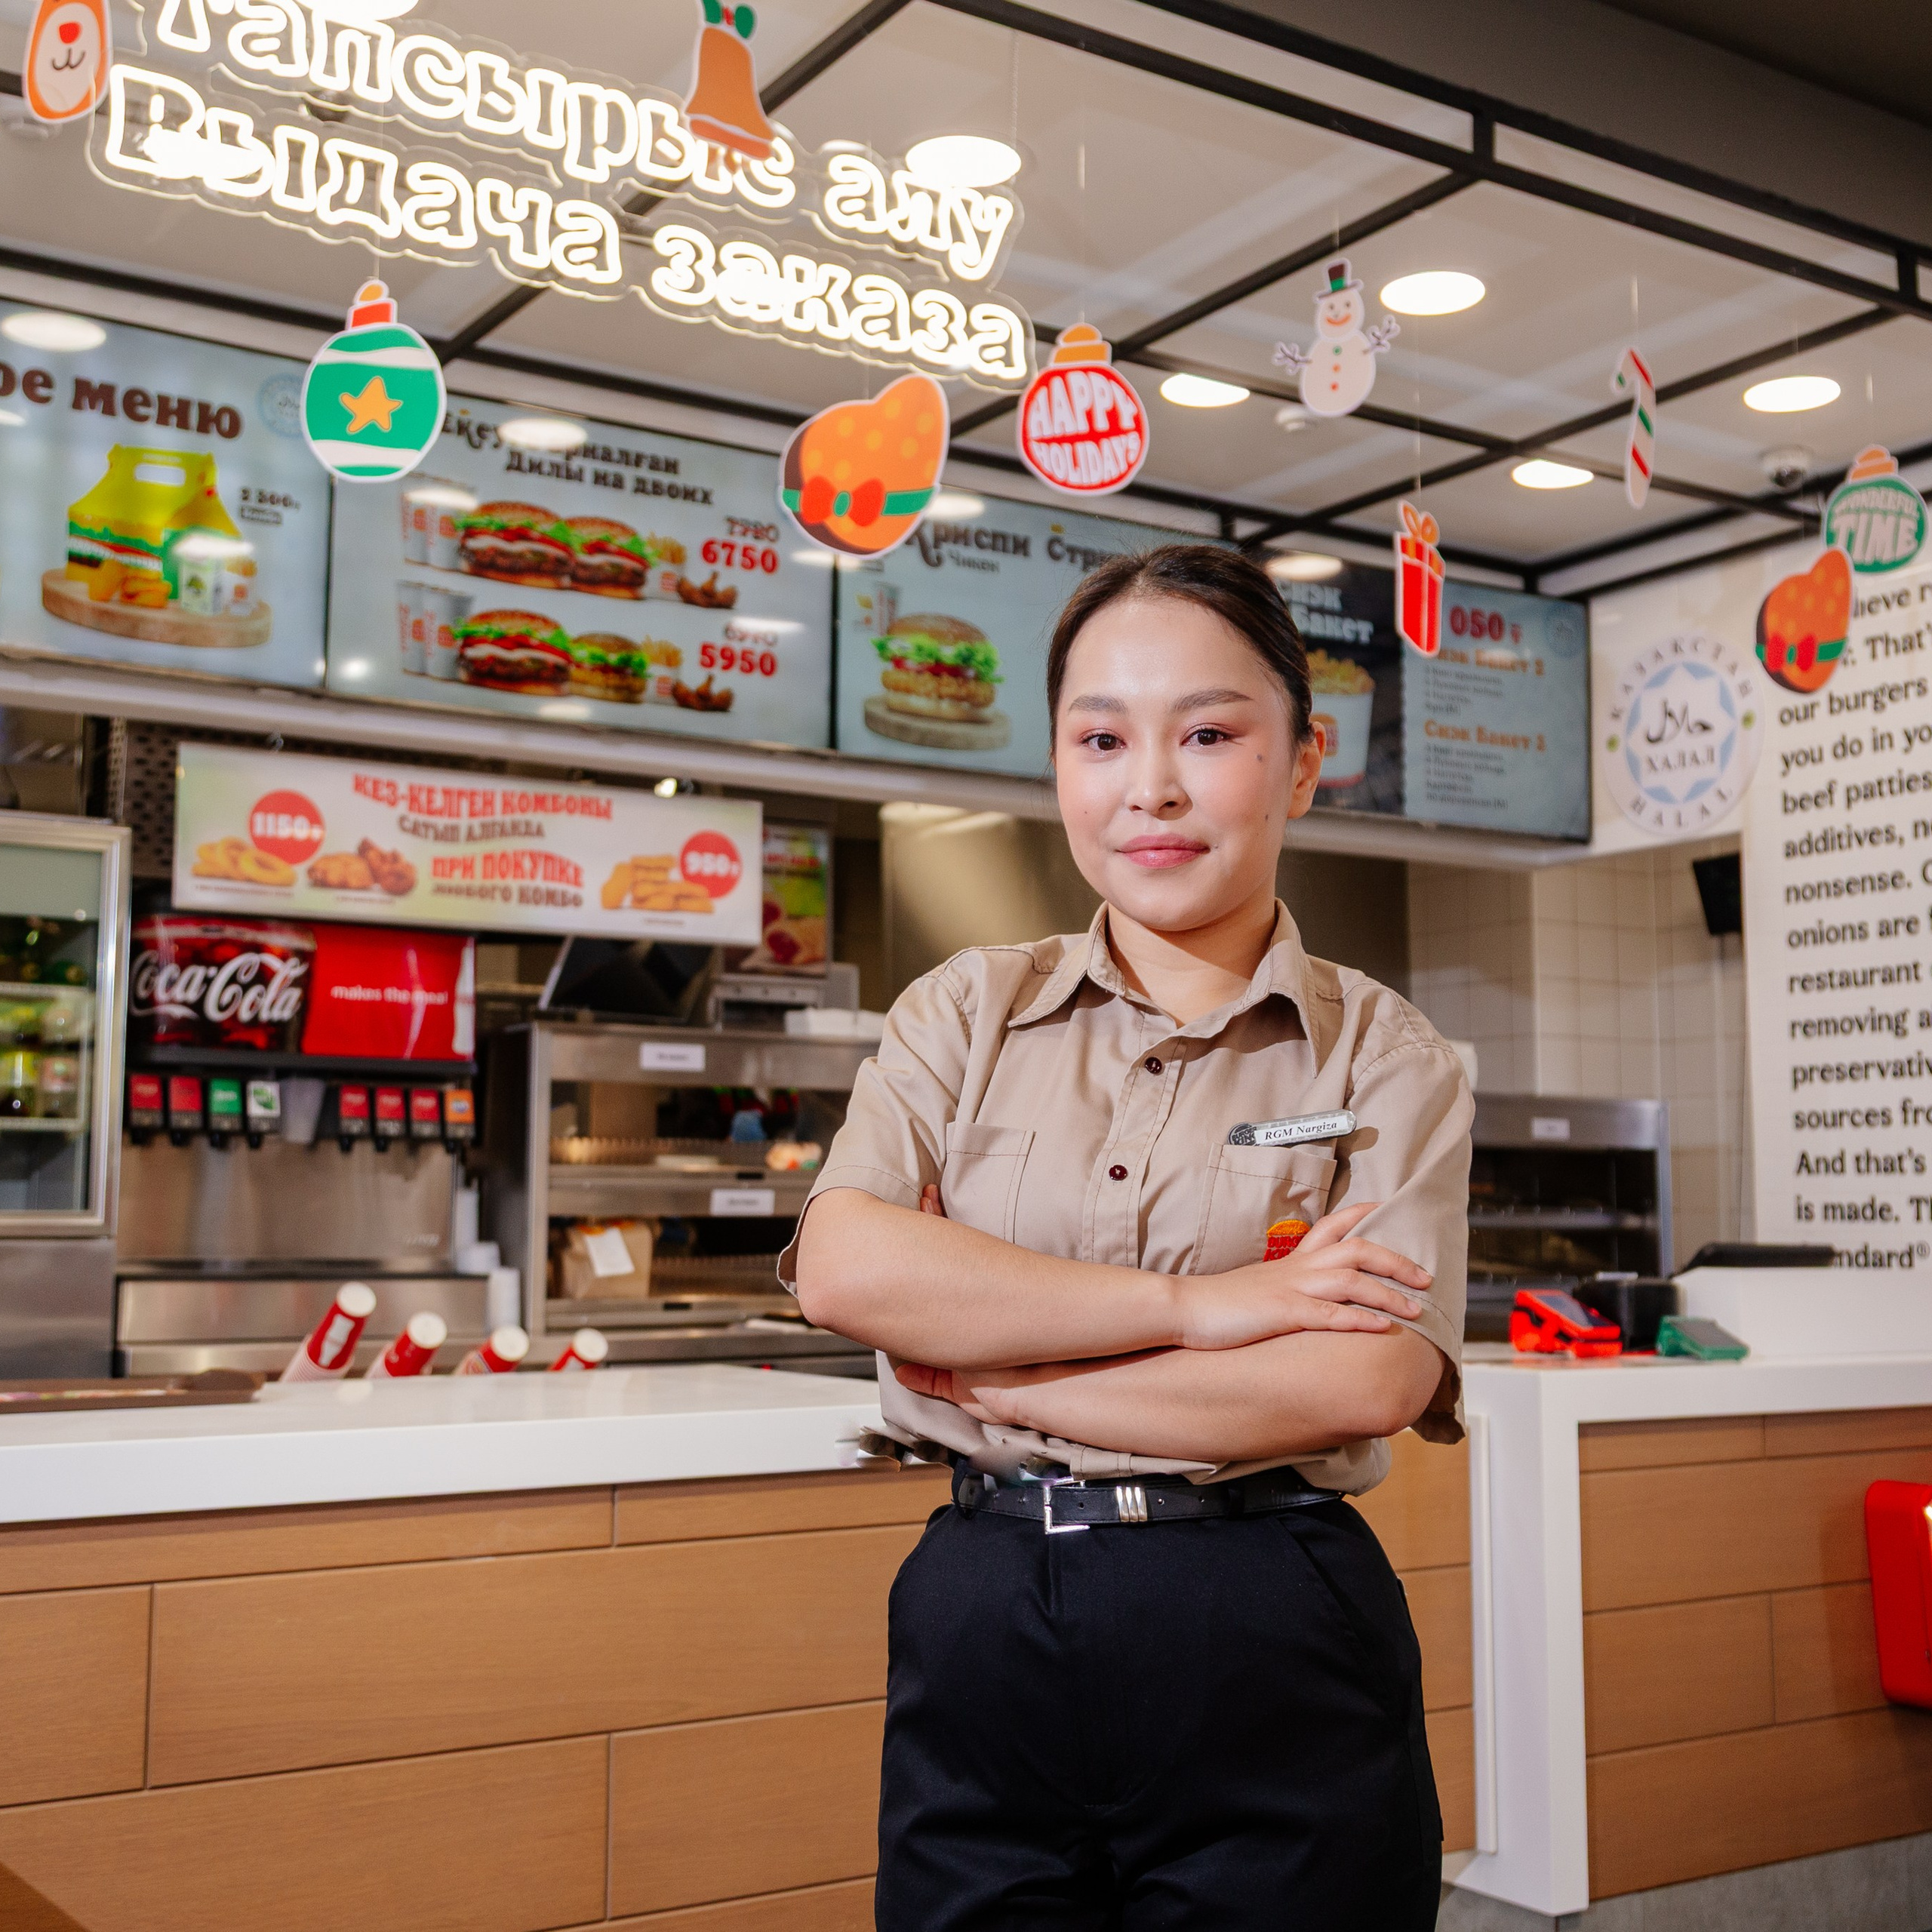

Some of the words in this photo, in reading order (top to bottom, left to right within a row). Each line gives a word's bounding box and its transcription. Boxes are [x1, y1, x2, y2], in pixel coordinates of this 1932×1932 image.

[105, 64, 623, 284] Выдача
[651, 223, 1029, 379] заказа
[72, 376, 245, 439] меню
[1029, 371, 1139, 438] HAPPY
[1030, 430, 1142, 485] HOLIDAYS
[506, 451, 584, 483] Дилы
[593, 468, 625, 491] на
[634, 474, 714, 506] двоих
[1834, 486, 1918, 519] WONDERFUL
[1832, 510, 1919, 565] TIME
[700, 538, 779, 575] 6750
[699, 641, 778, 677] 5950
[1779, 701, 1820, 727] our
[1829, 678, 1928, 716] burgers
[1780, 745, 1825, 777] you
[1832, 733, 1864, 761] do
[1872, 725, 1895, 753] in
[352, 772, 495, 819] КЕЗ-КЕЛГЕН
[501, 789, 613, 821] КОМБОНЫ
[1783, 779, 1838, 815] beef
[397, 813, 460, 843] САТЫП
[1783, 823, 1906, 860] additives,
[432, 855, 475, 880] ПРИ
[481, 848, 583, 888] ПОКУПКЕ
[517, 887, 583, 907] КОМБО
[1785, 869, 1914, 904] nonsense.
[1787, 918, 1870, 949] onions
[1878, 914, 1921, 937] are
[129, 949, 309, 1024] Coca-Cola
[331, 985, 383, 1002] makes
[1788, 960, 1922, 994] restaurant
[1789, 1005, 1911, 1041] removing
[1265, 1128, 1294, 1140] RGM
[1296, 1120, 1337, 1134] Nargiza
[1793, 1106, 1894, 1131] sources
[1795, 1147, 1847, 1177] And
[1854, 1146, 1927, 1175] that's
[1795, 1192, 1815, 1223] is
[1823, 1193, 1901, 1223] made.
[1267, 1235, 1305, 1248] BURG
